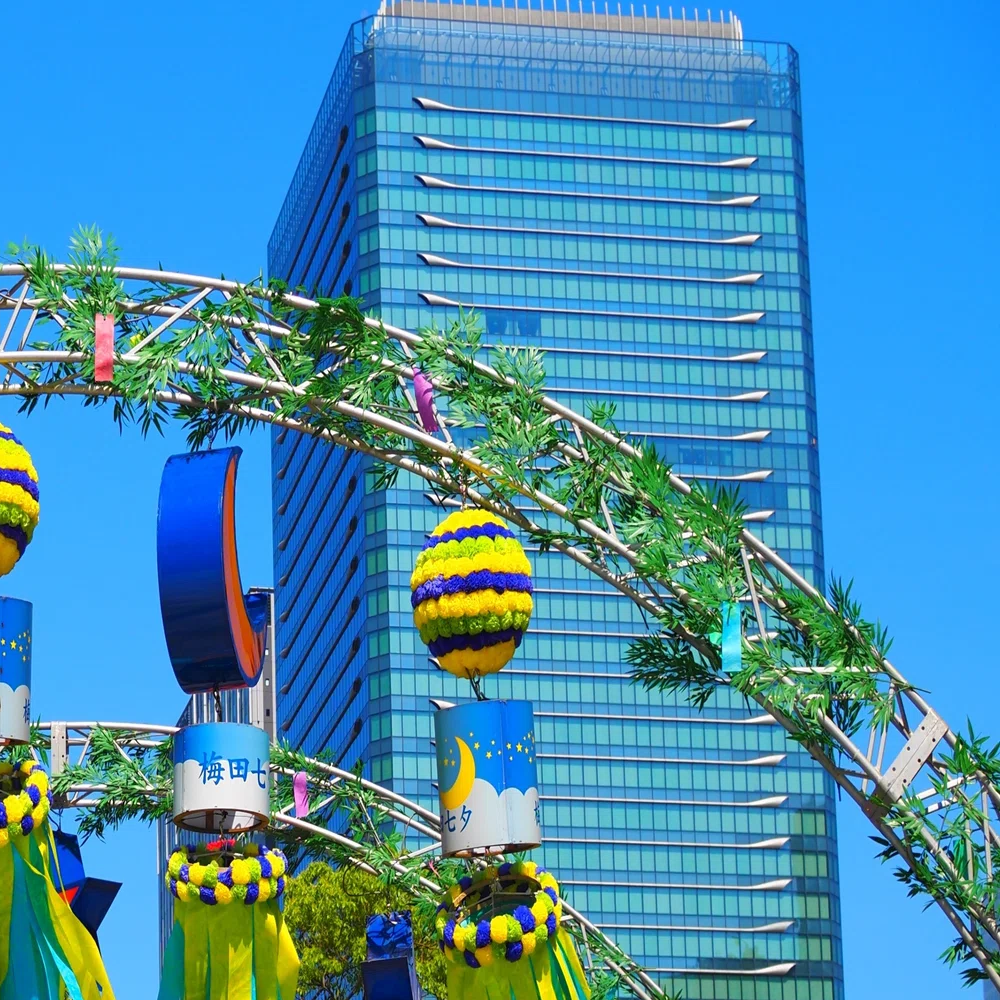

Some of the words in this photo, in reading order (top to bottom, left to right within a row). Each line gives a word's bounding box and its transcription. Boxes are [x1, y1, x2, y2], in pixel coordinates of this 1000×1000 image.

[198, 750, 267, 789] 梅田七
[440, 804, 472, 833] 七夕
